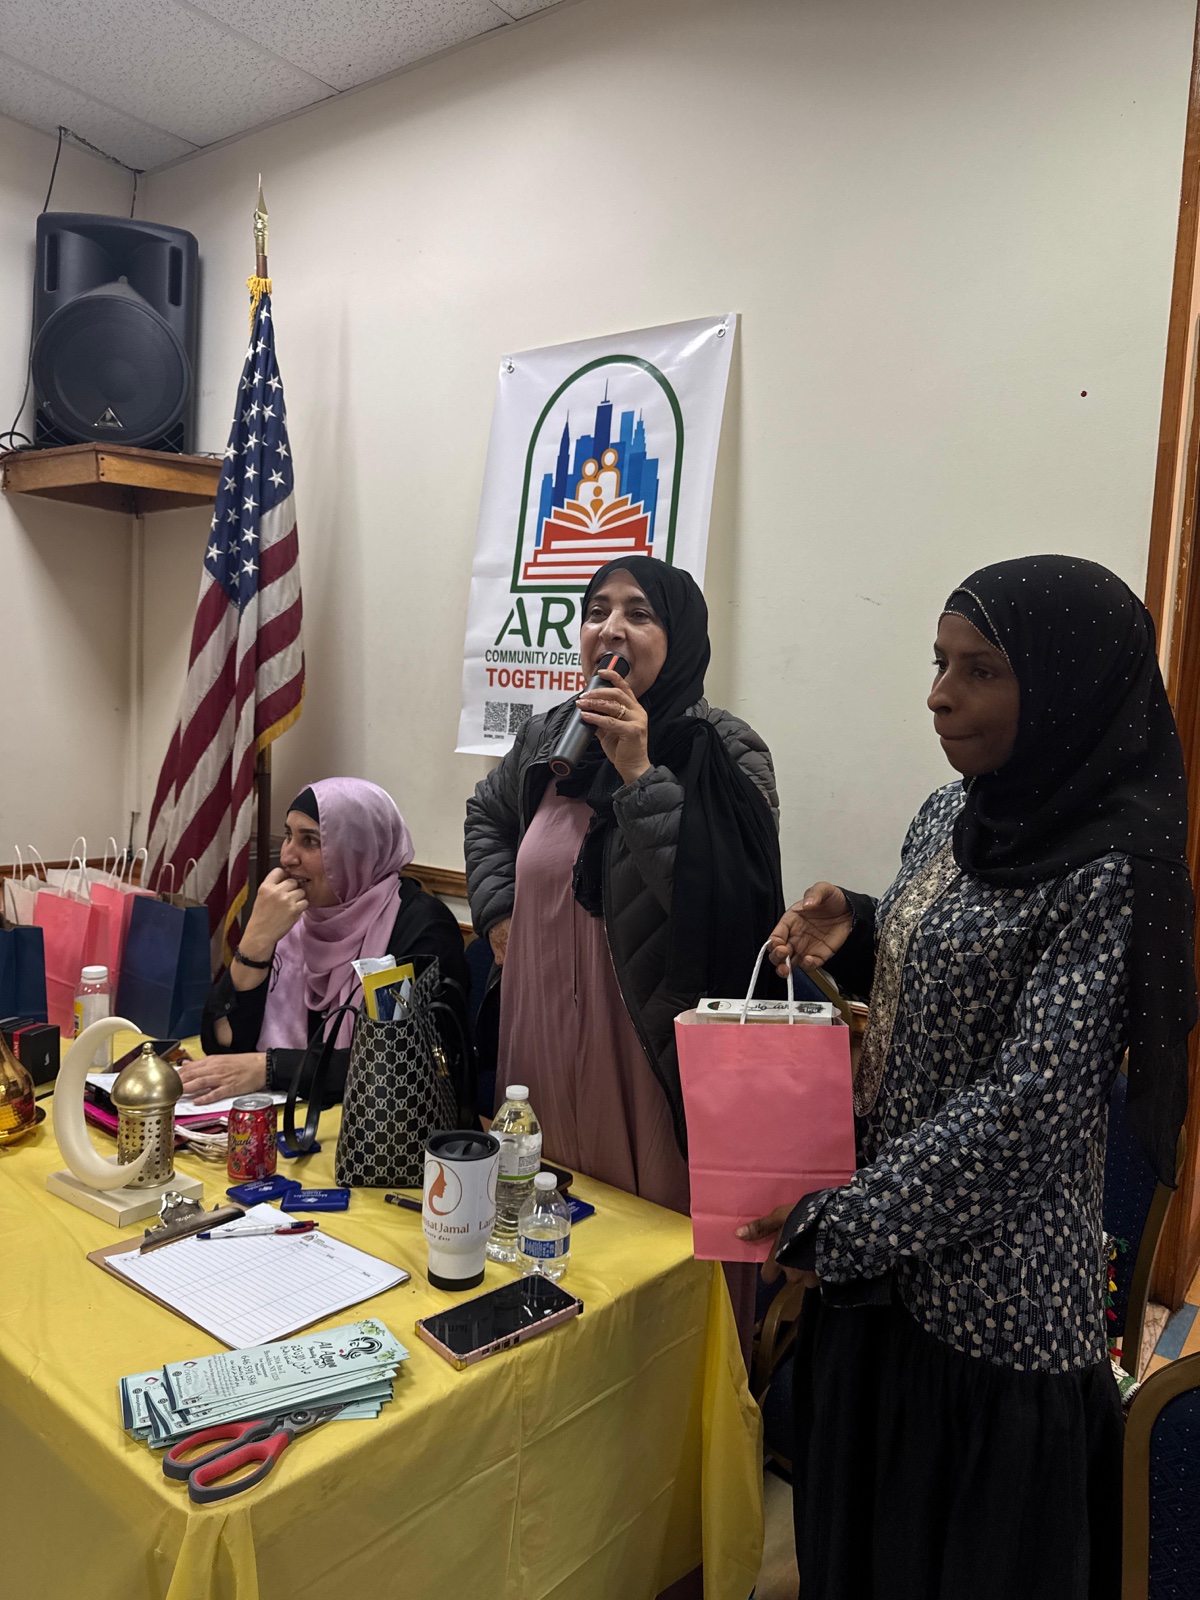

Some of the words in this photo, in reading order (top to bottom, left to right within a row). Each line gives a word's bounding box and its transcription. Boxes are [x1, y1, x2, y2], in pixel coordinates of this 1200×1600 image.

[494, 596, 584, 650] AR
[485, 649, 548, 665] COMMUNITY
[486, 667, 587, 692] TOGETHER
[438, 1223, 469, 1234] Jamal
